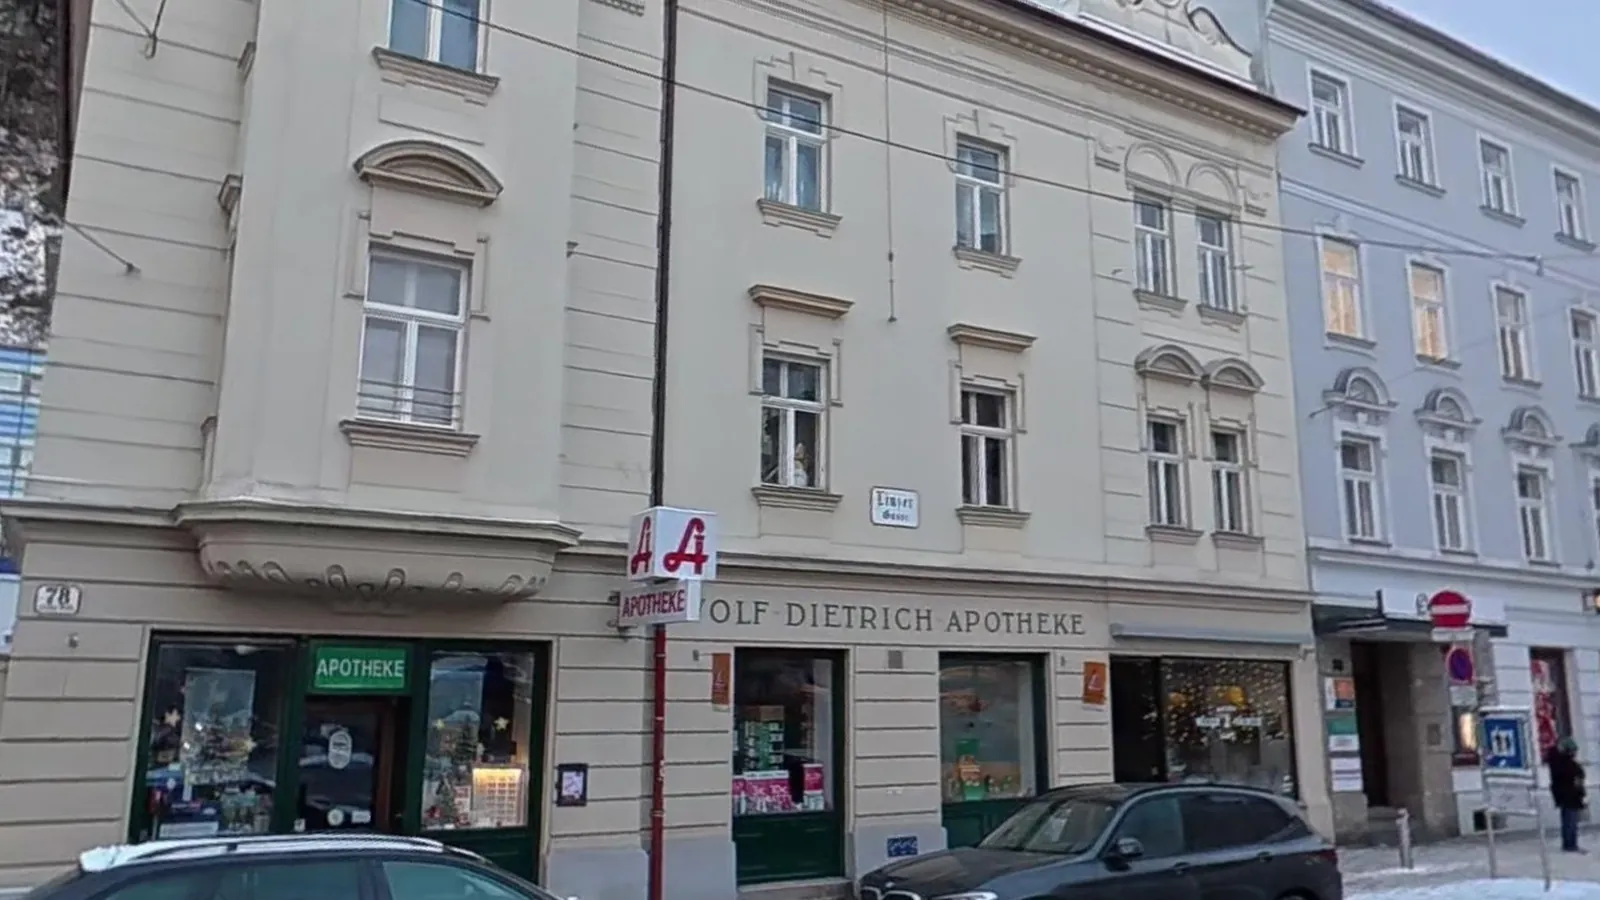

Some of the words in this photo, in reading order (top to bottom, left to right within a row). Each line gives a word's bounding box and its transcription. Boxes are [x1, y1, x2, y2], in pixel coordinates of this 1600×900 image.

[621, 589, 686, 618] APOTHEKE
[700, 598, 769, 625] OLF
[945, 610, 1086, 636] APOTHEKE
[316, 657, 405, 678] APOTHEKE
